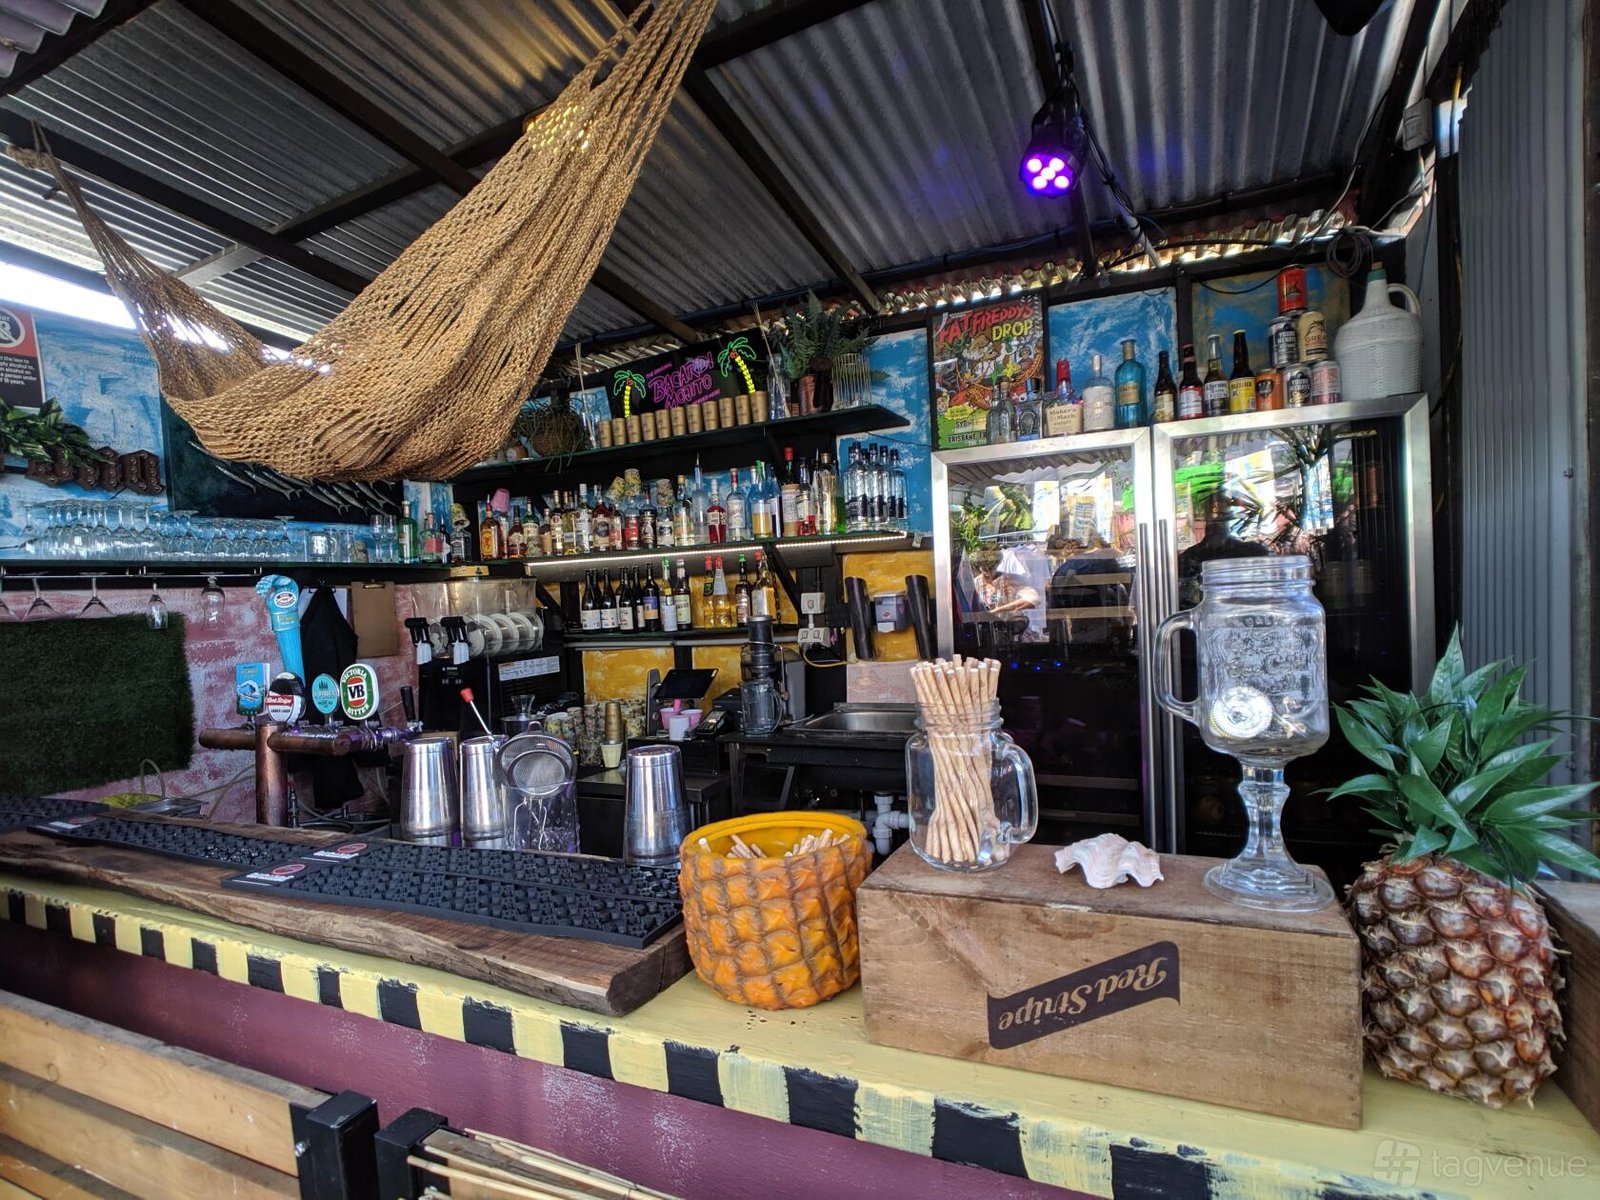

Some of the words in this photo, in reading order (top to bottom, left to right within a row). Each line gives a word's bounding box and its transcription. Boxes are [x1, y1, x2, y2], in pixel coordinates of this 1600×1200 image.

[992, 319, 1034, 341] DROP
[648, 351, 714, 403] BACARDI
[664, 374, 713, 410] MOJITO
[341, 668, 368, 683] VICTORIA
[348, 684, 366, 699] VB
[347, 703, 370, 715] BITTER
[1093, 956, 1168, 1004] Red
[999, 983, 1094, 1031] Stripe
